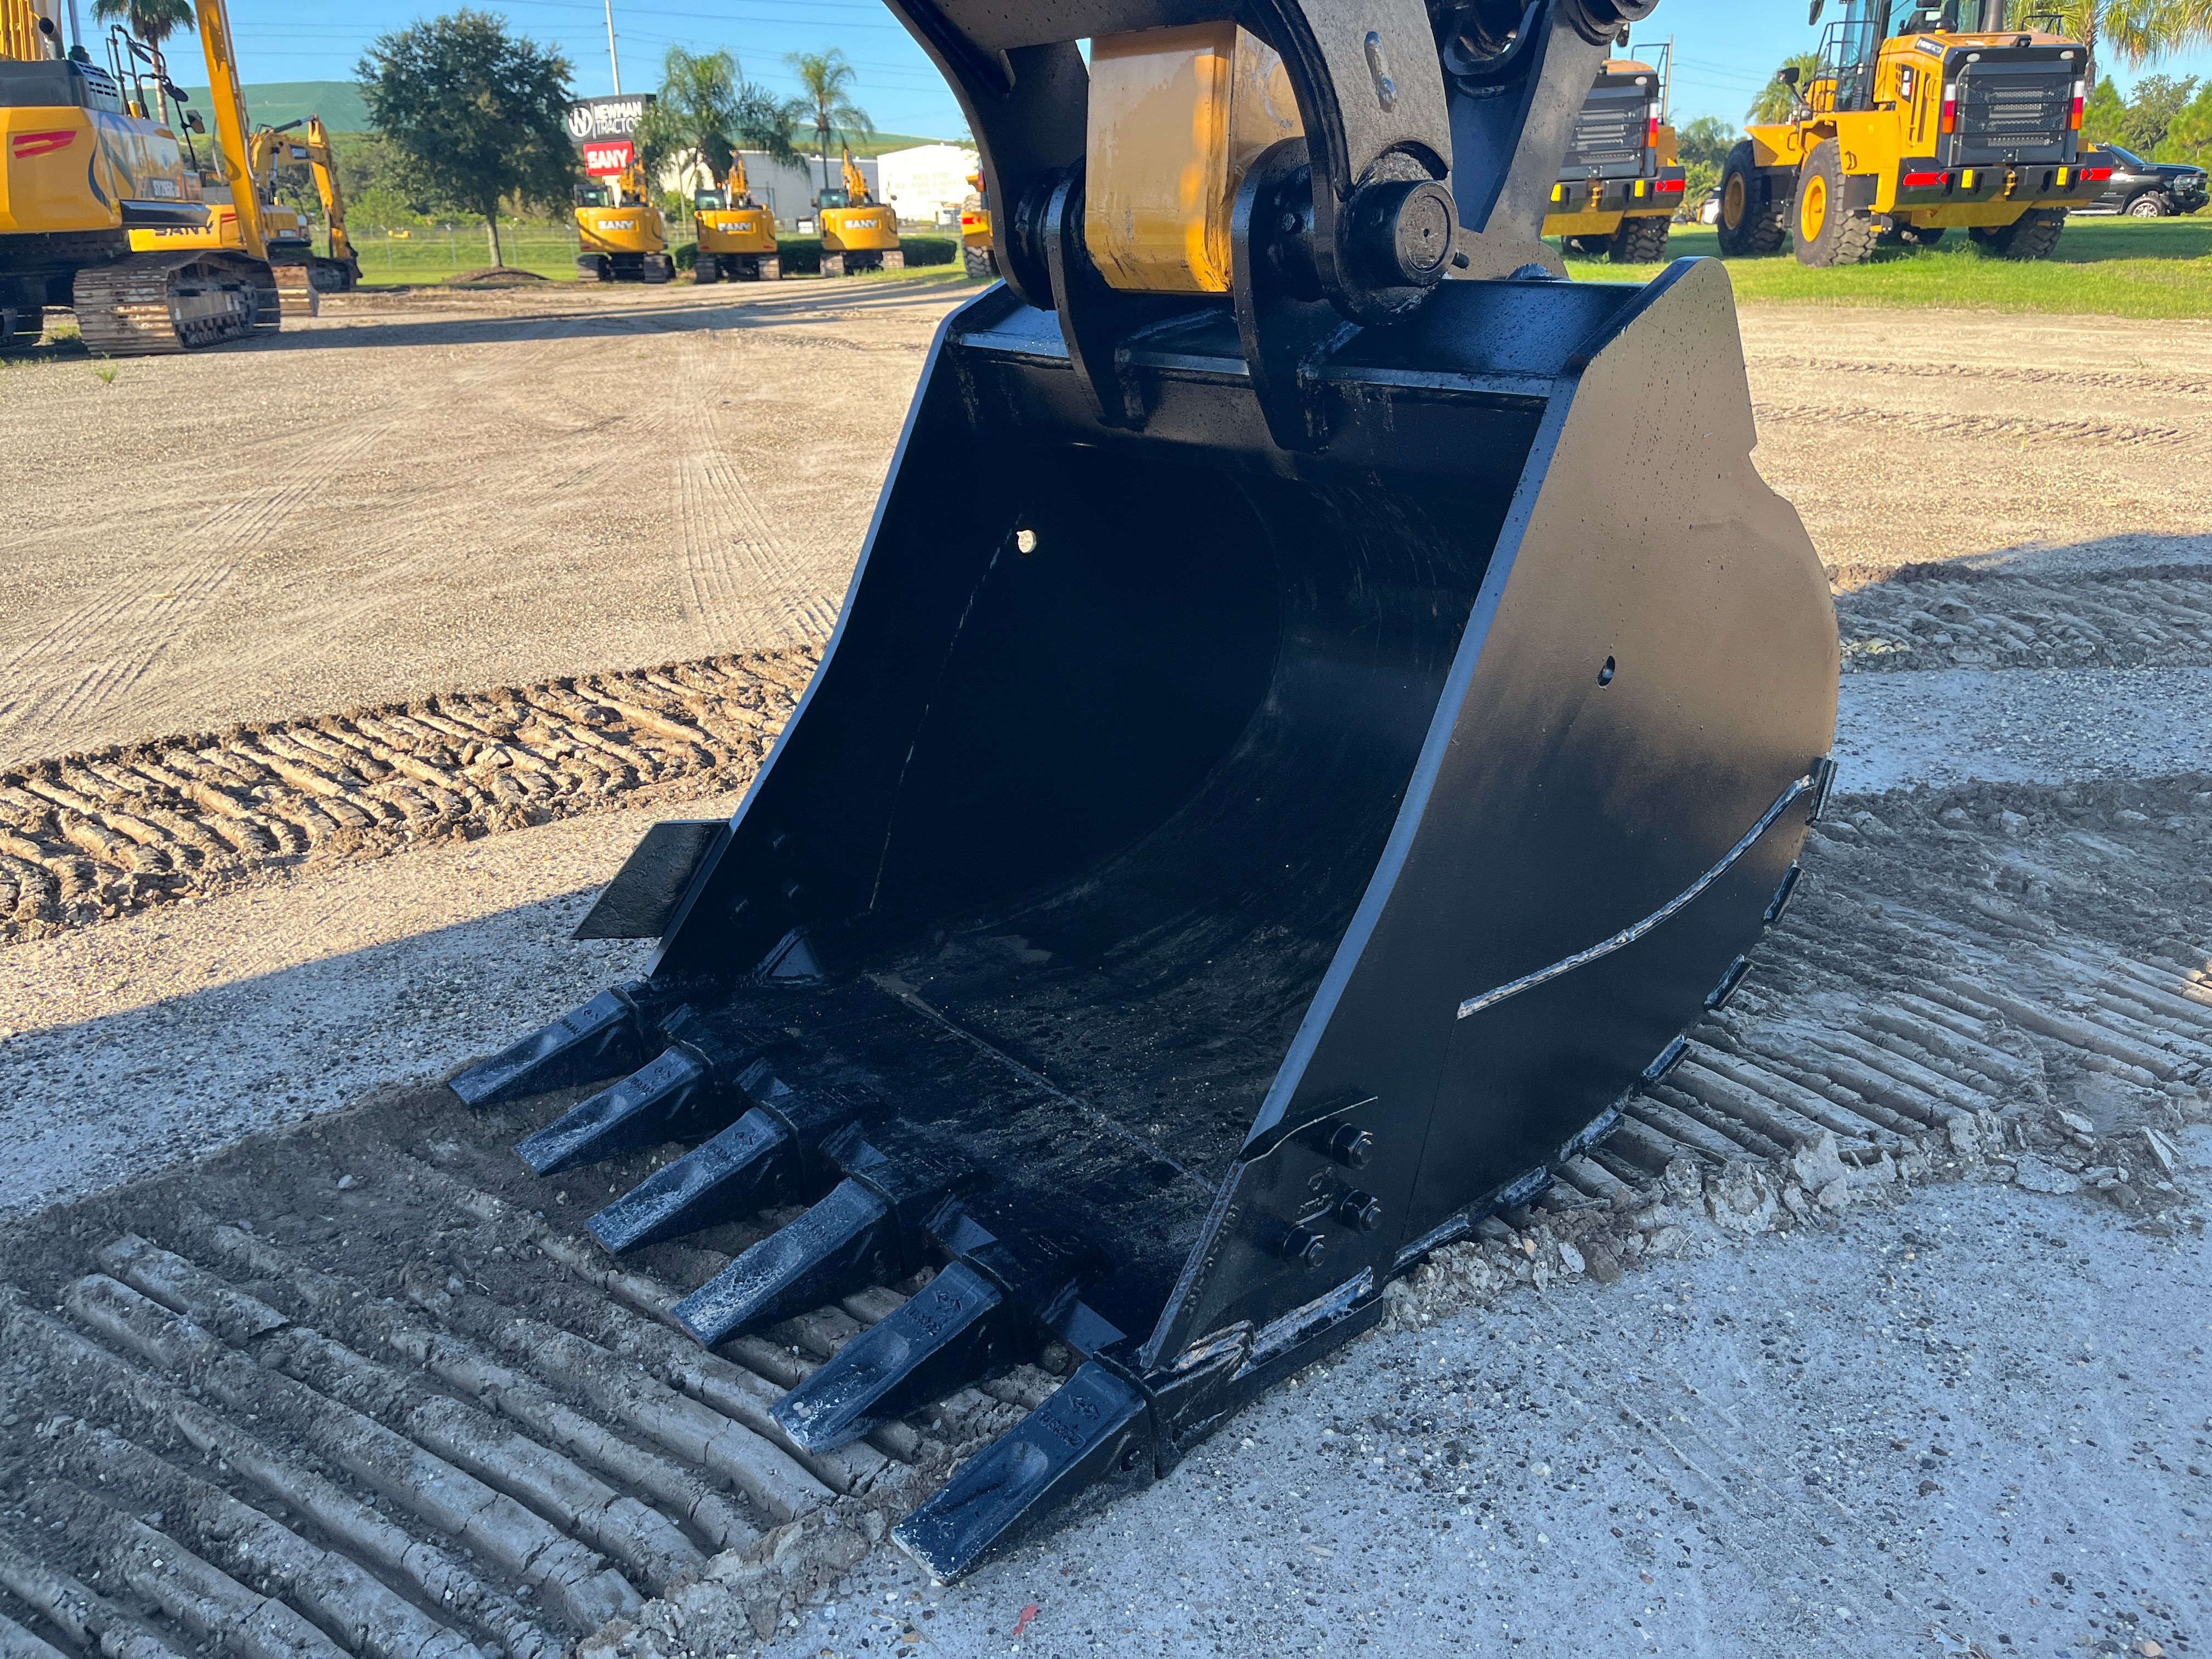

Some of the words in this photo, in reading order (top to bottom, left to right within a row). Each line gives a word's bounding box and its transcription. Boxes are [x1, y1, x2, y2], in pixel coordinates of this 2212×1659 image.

[594, 101, 642, 119] NEWMAN
[587, 149, 628, 169] SANY
[597, 220, 634, 230] SANY
[845, 219, 878, 229] SANY
